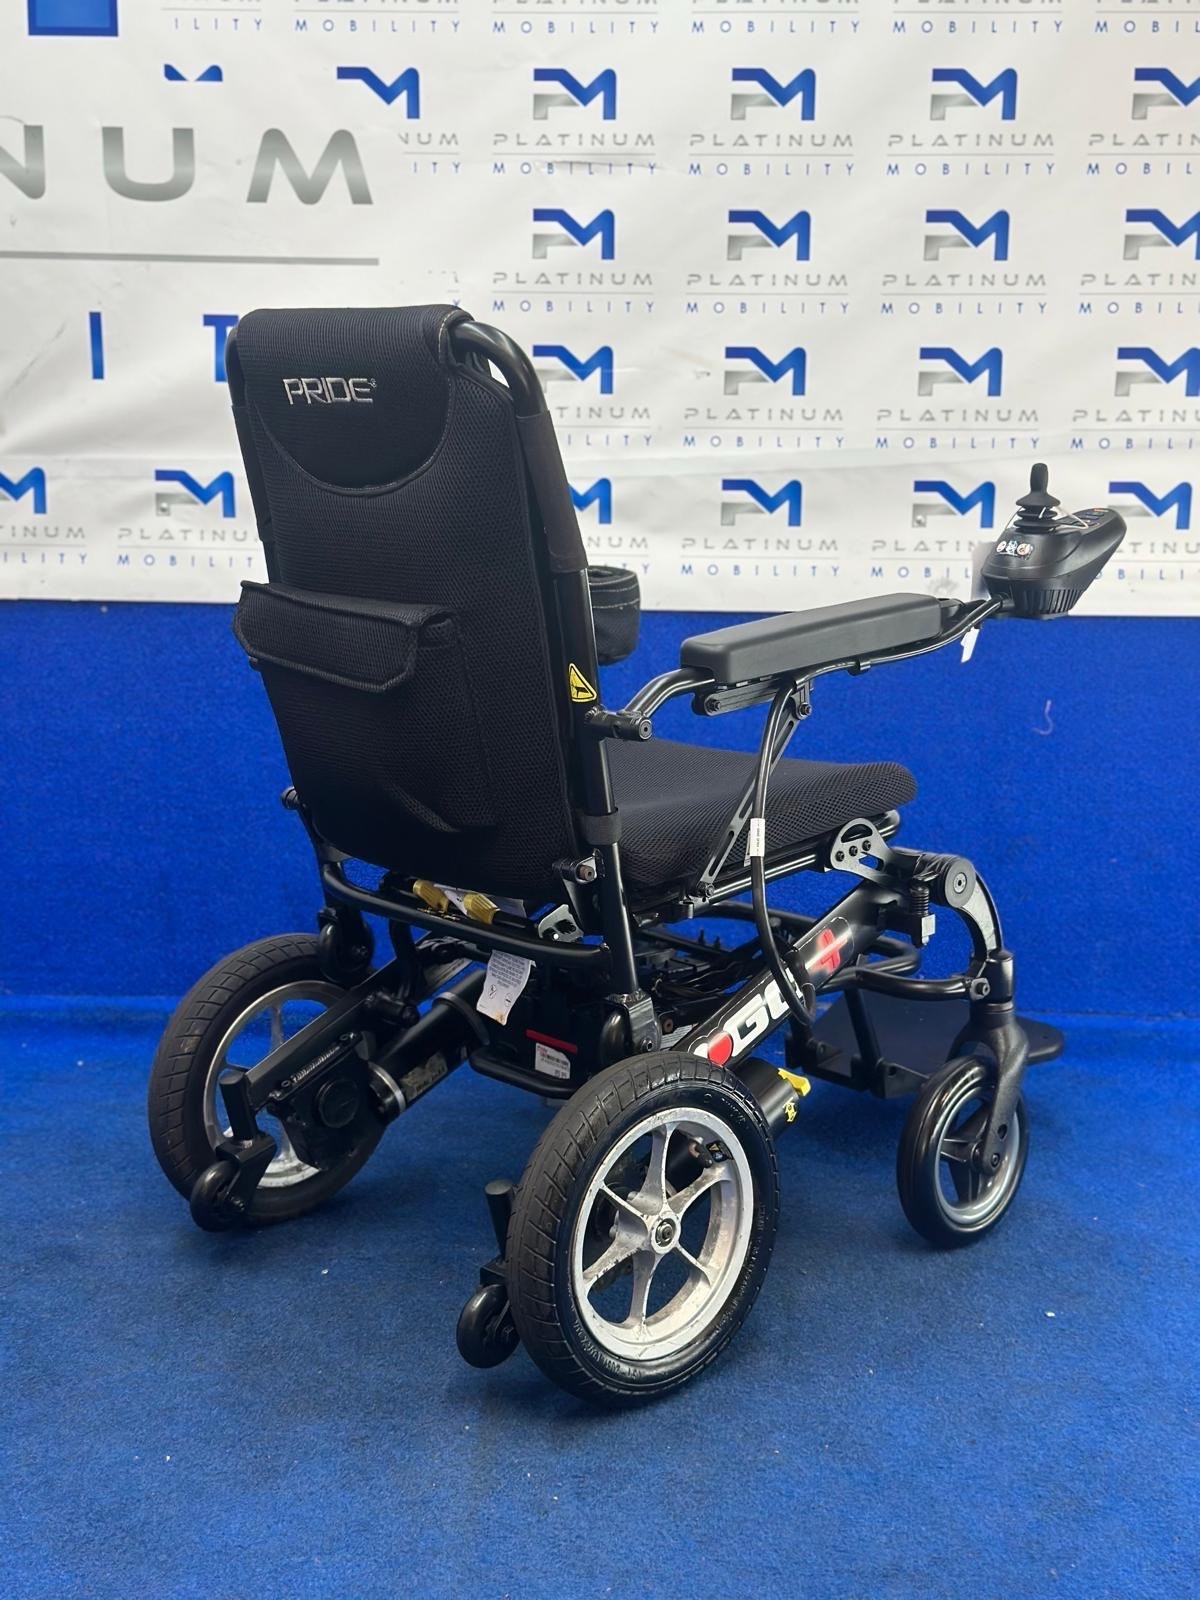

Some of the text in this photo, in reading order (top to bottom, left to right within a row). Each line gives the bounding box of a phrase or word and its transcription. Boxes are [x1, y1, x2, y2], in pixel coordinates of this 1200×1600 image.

[295, 19, 459, 32] MOBILITY
[493, 21, 658, 34] MOBILITY
[692, 21, 859, 33] MOBILITY
[893, 20, 1062, 33] MOBILITY
[493, 133, 655, 146] PLATINUM
[690, 134, 853, 147] PLATINUM
[888, 133, 1054, 147] PLATINUM
[493, 162, 656, 175] MOBILITY
[689, 163, 853, 176] MOBILITY
[887, 163, 1054, 175] MOBILITY
[1087, 163, 1192, 175] MOBIL
[493, 272, 653, 286] PLATINUM
[686, 273, 848, 286] PLATINUM
[882, 274, 1046, 286] PLATINUM
[1081, 273, 1196, 286] PLATIN
[493, 300, 654, 312] MOBILITY
[686, 302, 848, 314] MOBILITY
[880, 302, 1046, 314] MOBILITY
[556, 406, 650, 419] TINUM
[684, 408, 843, 421] PLATINUM
[877, 409, 1038, 422] PLATINUM
[568, 434, 652, 446] ILITY
[683, 435, 844, 448] MOBILITY
[876, 437, 1039, 449] MOBILITY
[1070, 438, 1192, 450] MOBILI
[0, 526, 85, 539] INUM
[118, 528, 256, 542] PLATINU
[682, 537, 838, 551] PLATINUM
[1117, 542, 1200, 554] TINU
[117, 554, 252, 567] MOBILIT
[681, 564, 839, 577] MOBILITY
